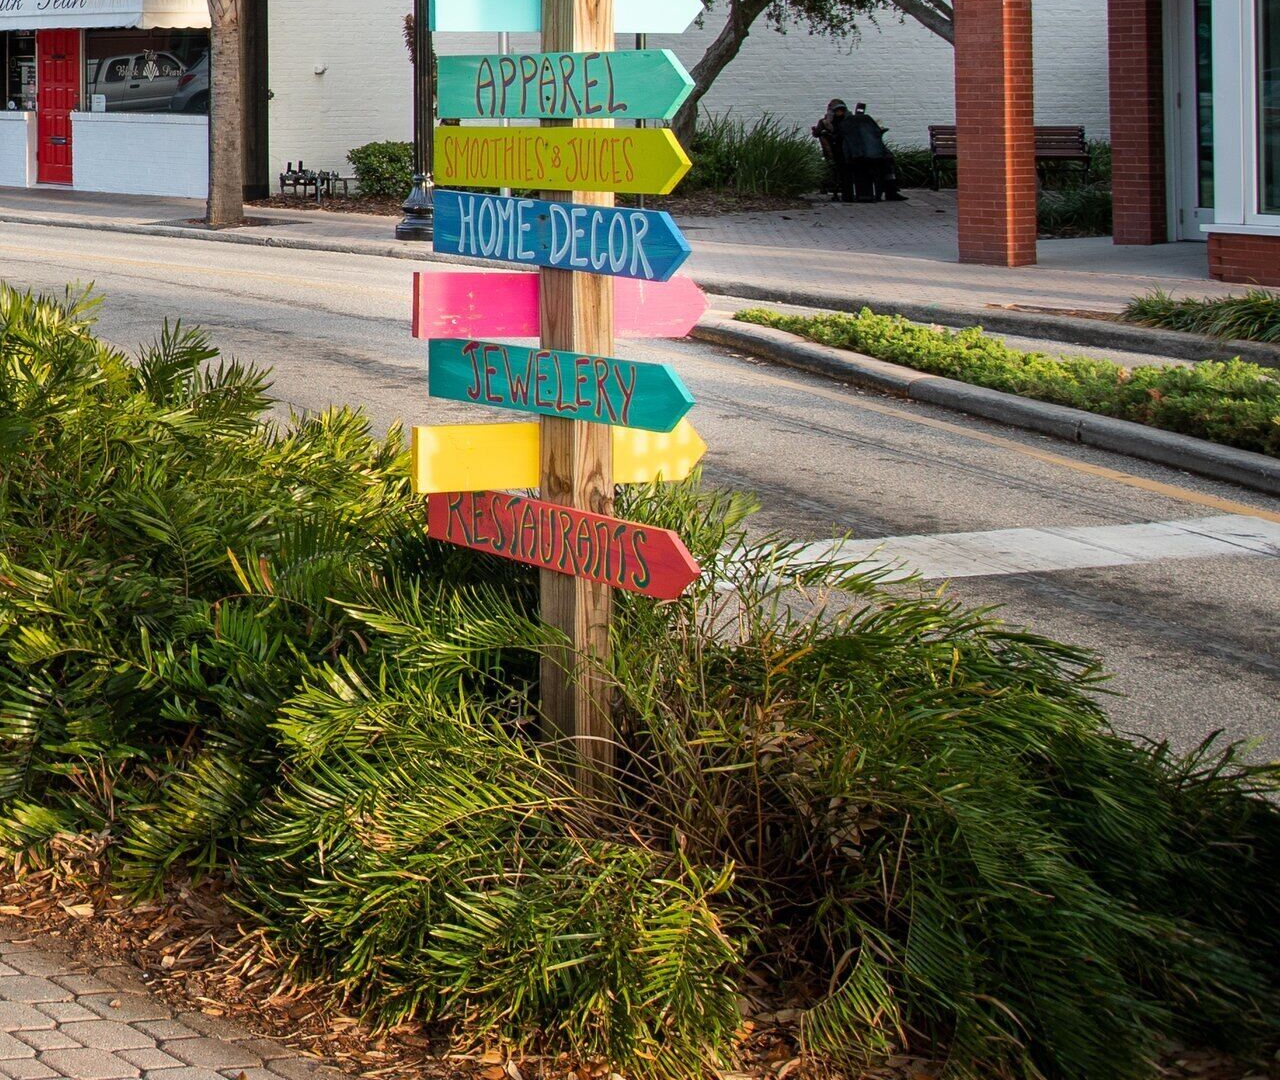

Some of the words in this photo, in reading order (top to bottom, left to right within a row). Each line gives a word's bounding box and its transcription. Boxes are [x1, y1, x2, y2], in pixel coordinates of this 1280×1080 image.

[115, 64, 139, 77] Black
[162, 64, 187, 77] Pearl
[142, 48, 158, 61] The
[475, 52, 628, 117] APPAREL
[444, 131, 545, 182] SMOOTHIES
[565, 132, 635, 185] JUICES
[456, 195, 536, 260] HOME
[549, 203, 655, 279] DECOR
[462, 340, 637, 425] JEWELERY
[445, 490, 651, 590] RESTAURANTS
